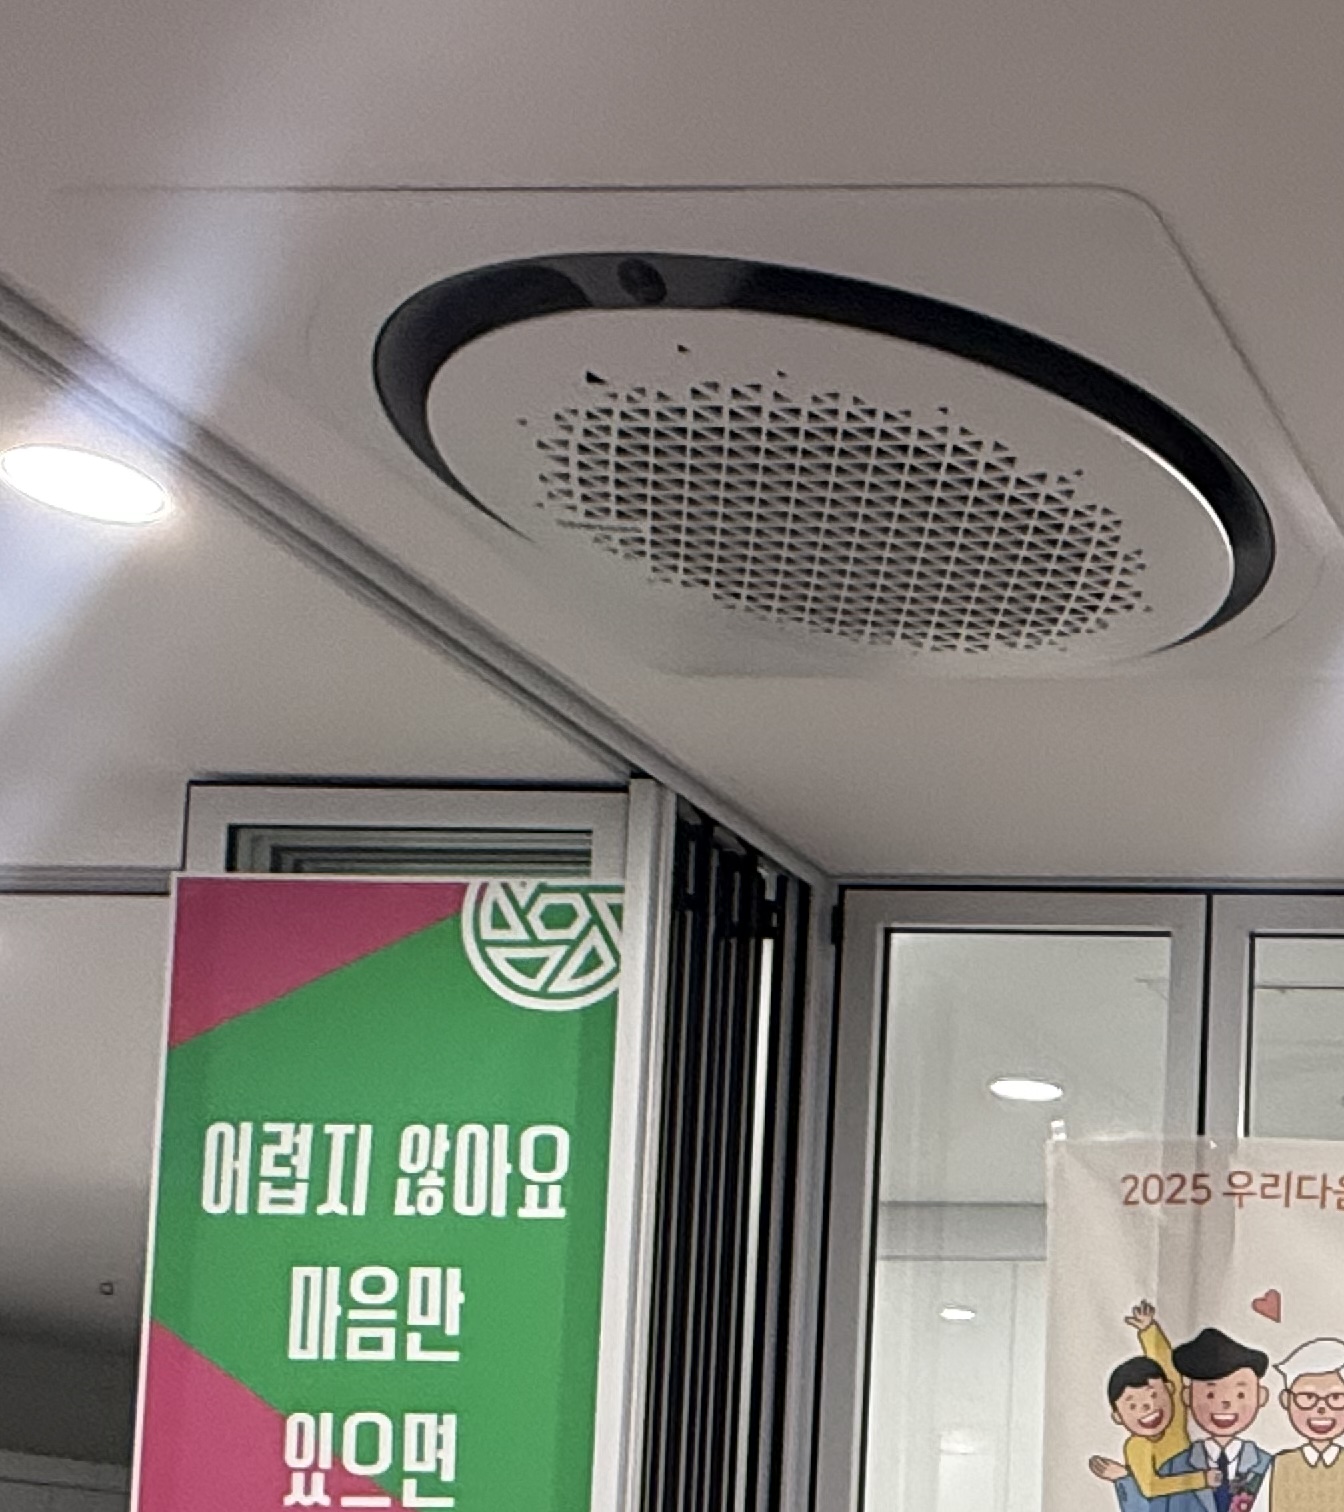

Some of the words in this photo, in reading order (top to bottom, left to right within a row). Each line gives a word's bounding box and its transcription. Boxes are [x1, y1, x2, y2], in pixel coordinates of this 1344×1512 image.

[201, 1121, 373, 1216] 어렵지
[393, 1123, 571, 1219] 않아요
[1121, 1172, 1212, 1206] 2025
[287, 1265, 465, 1361] 마음만
[283, 1411, 456, 1508] 있으면
